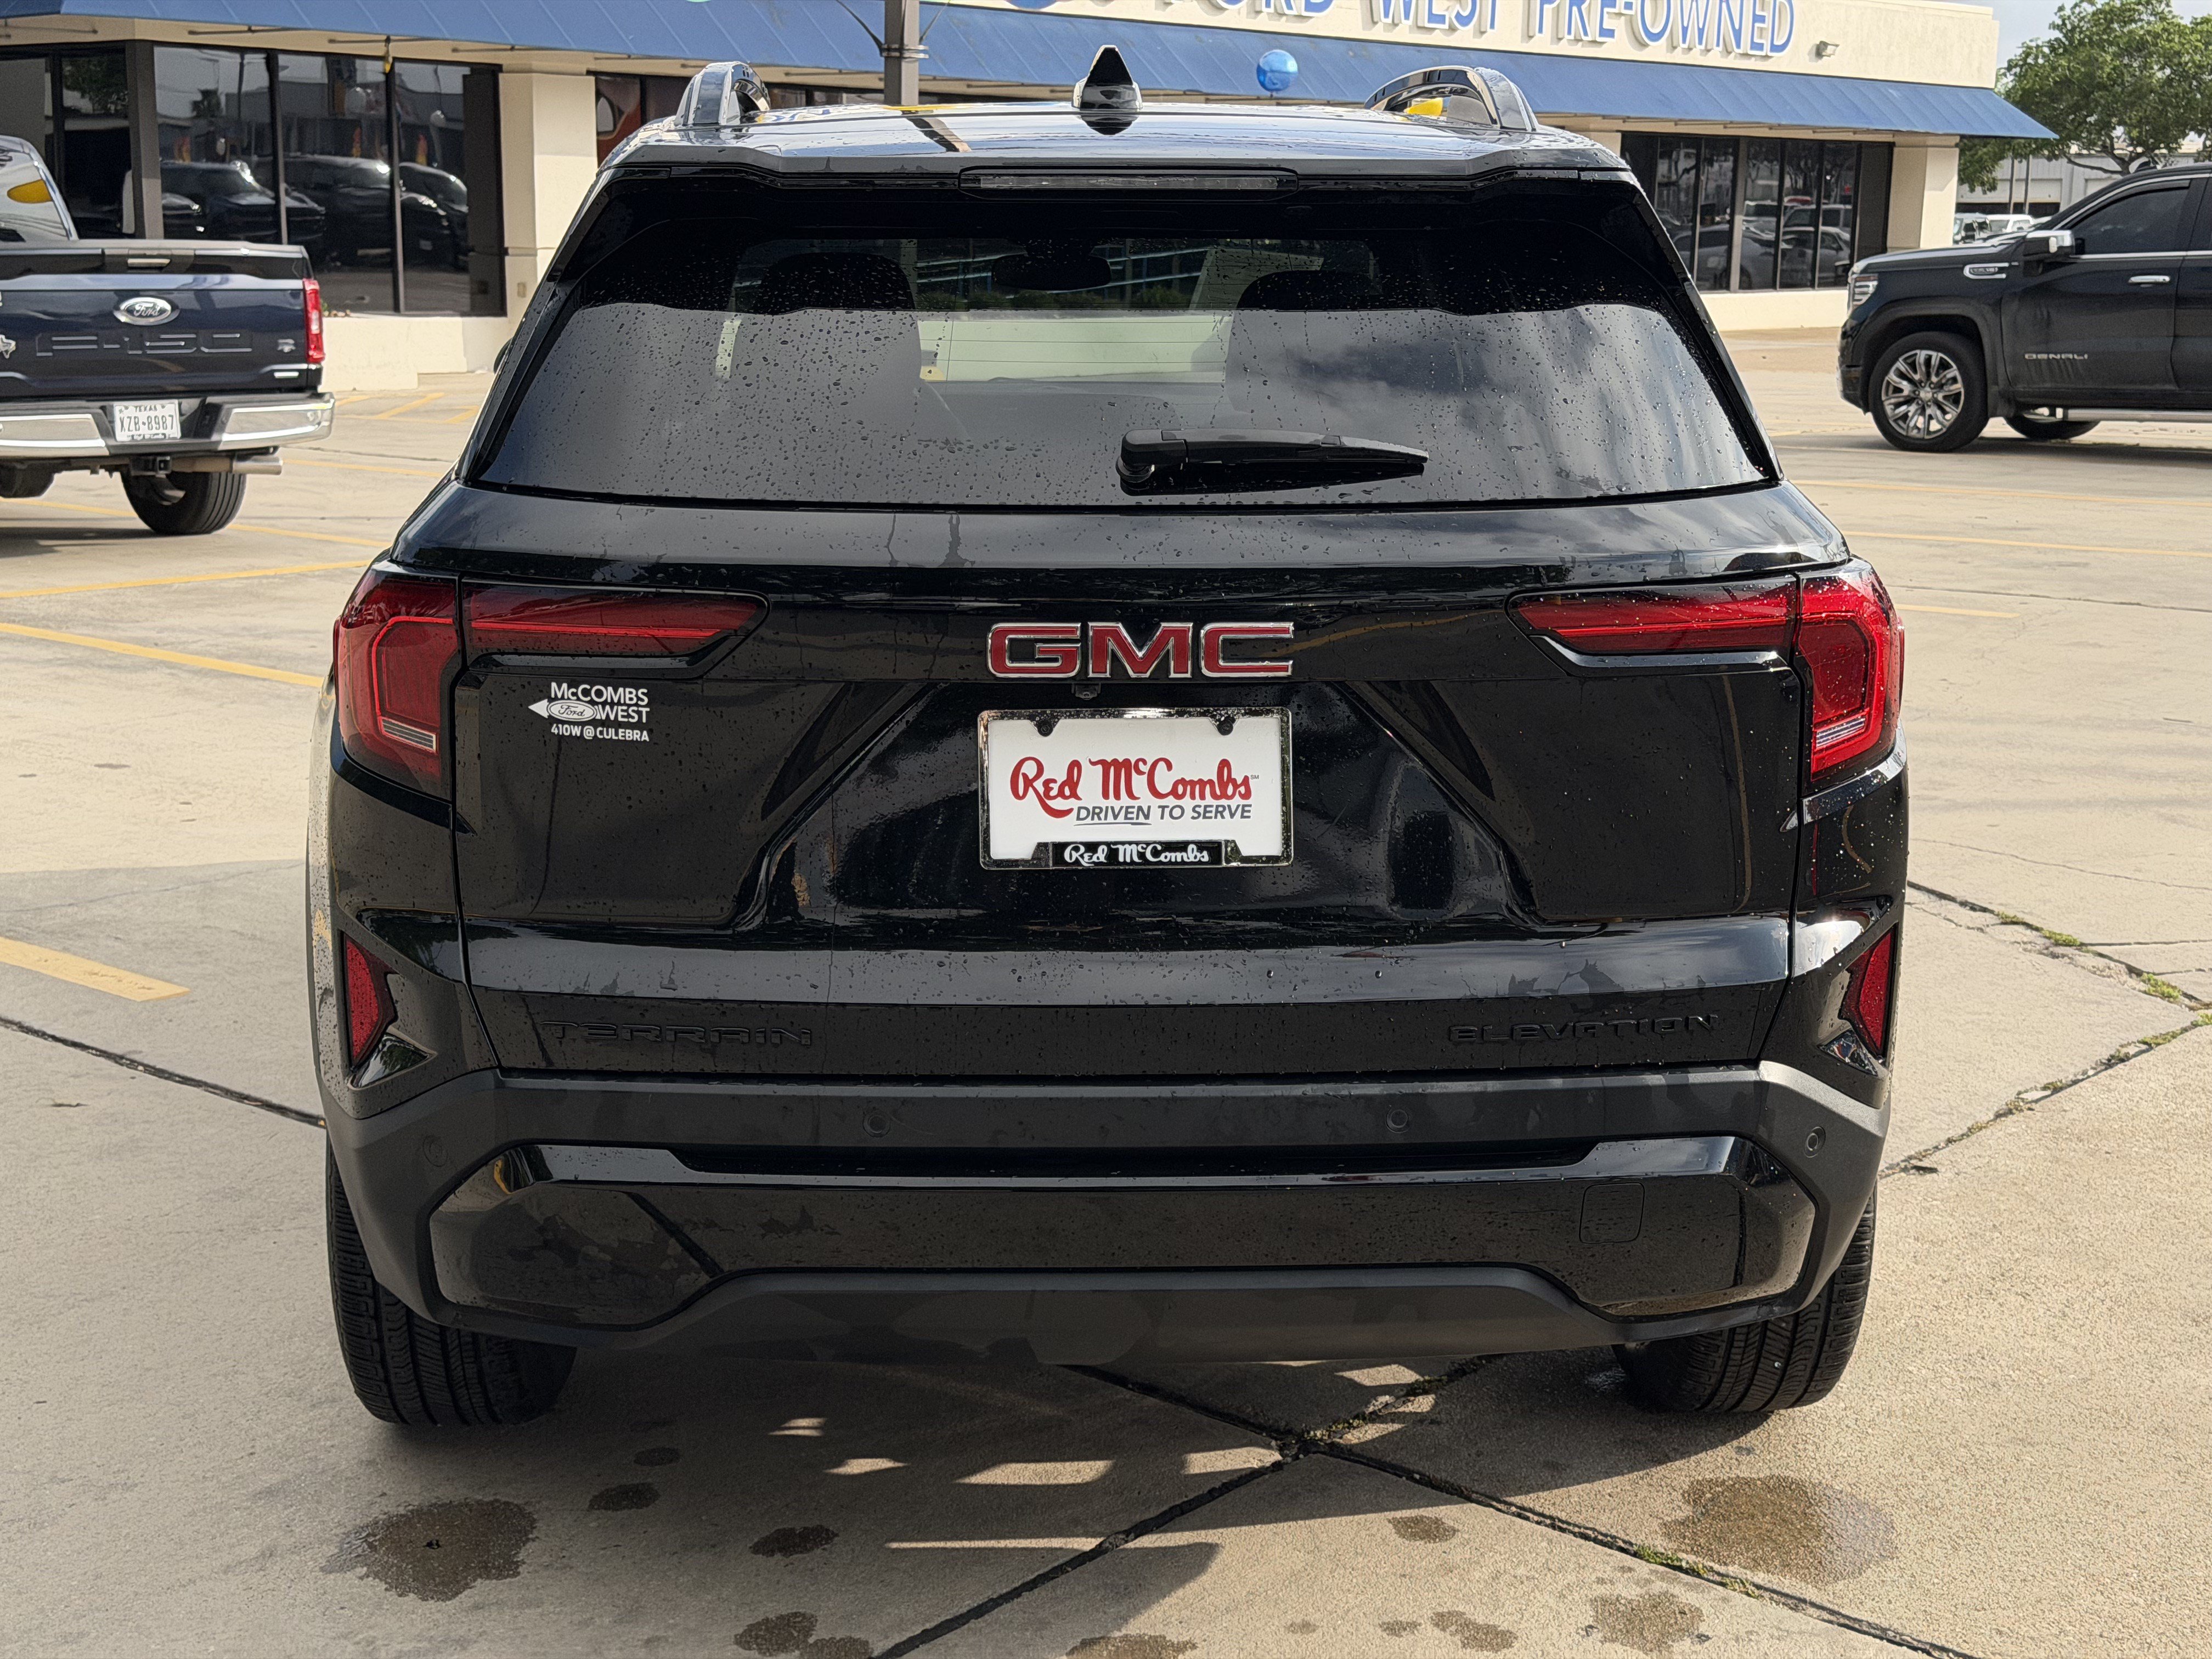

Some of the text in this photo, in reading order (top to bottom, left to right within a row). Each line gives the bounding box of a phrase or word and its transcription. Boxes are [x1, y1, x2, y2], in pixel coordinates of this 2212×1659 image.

[133, 303, 161, 317] Ford
[988, 622, 1294, 678] GMC
[551, 682, 648, 705] McCOMBS
[558, 704, 650, 723] Ford WEST
[596, 727, 650, 742] CULEBRA
[1010, 757, 1082, 819] Red
[1088, 757, 1252, 801] McCombs
[1076, 804, 1252, 821] DRIVEN TO SERVE
[1064, 844, 1209, 866] Red McCombs
[540, 1021, 811, 1046] TERRAIN
[1449, 1013, 1718, 1042] ELEVATION
